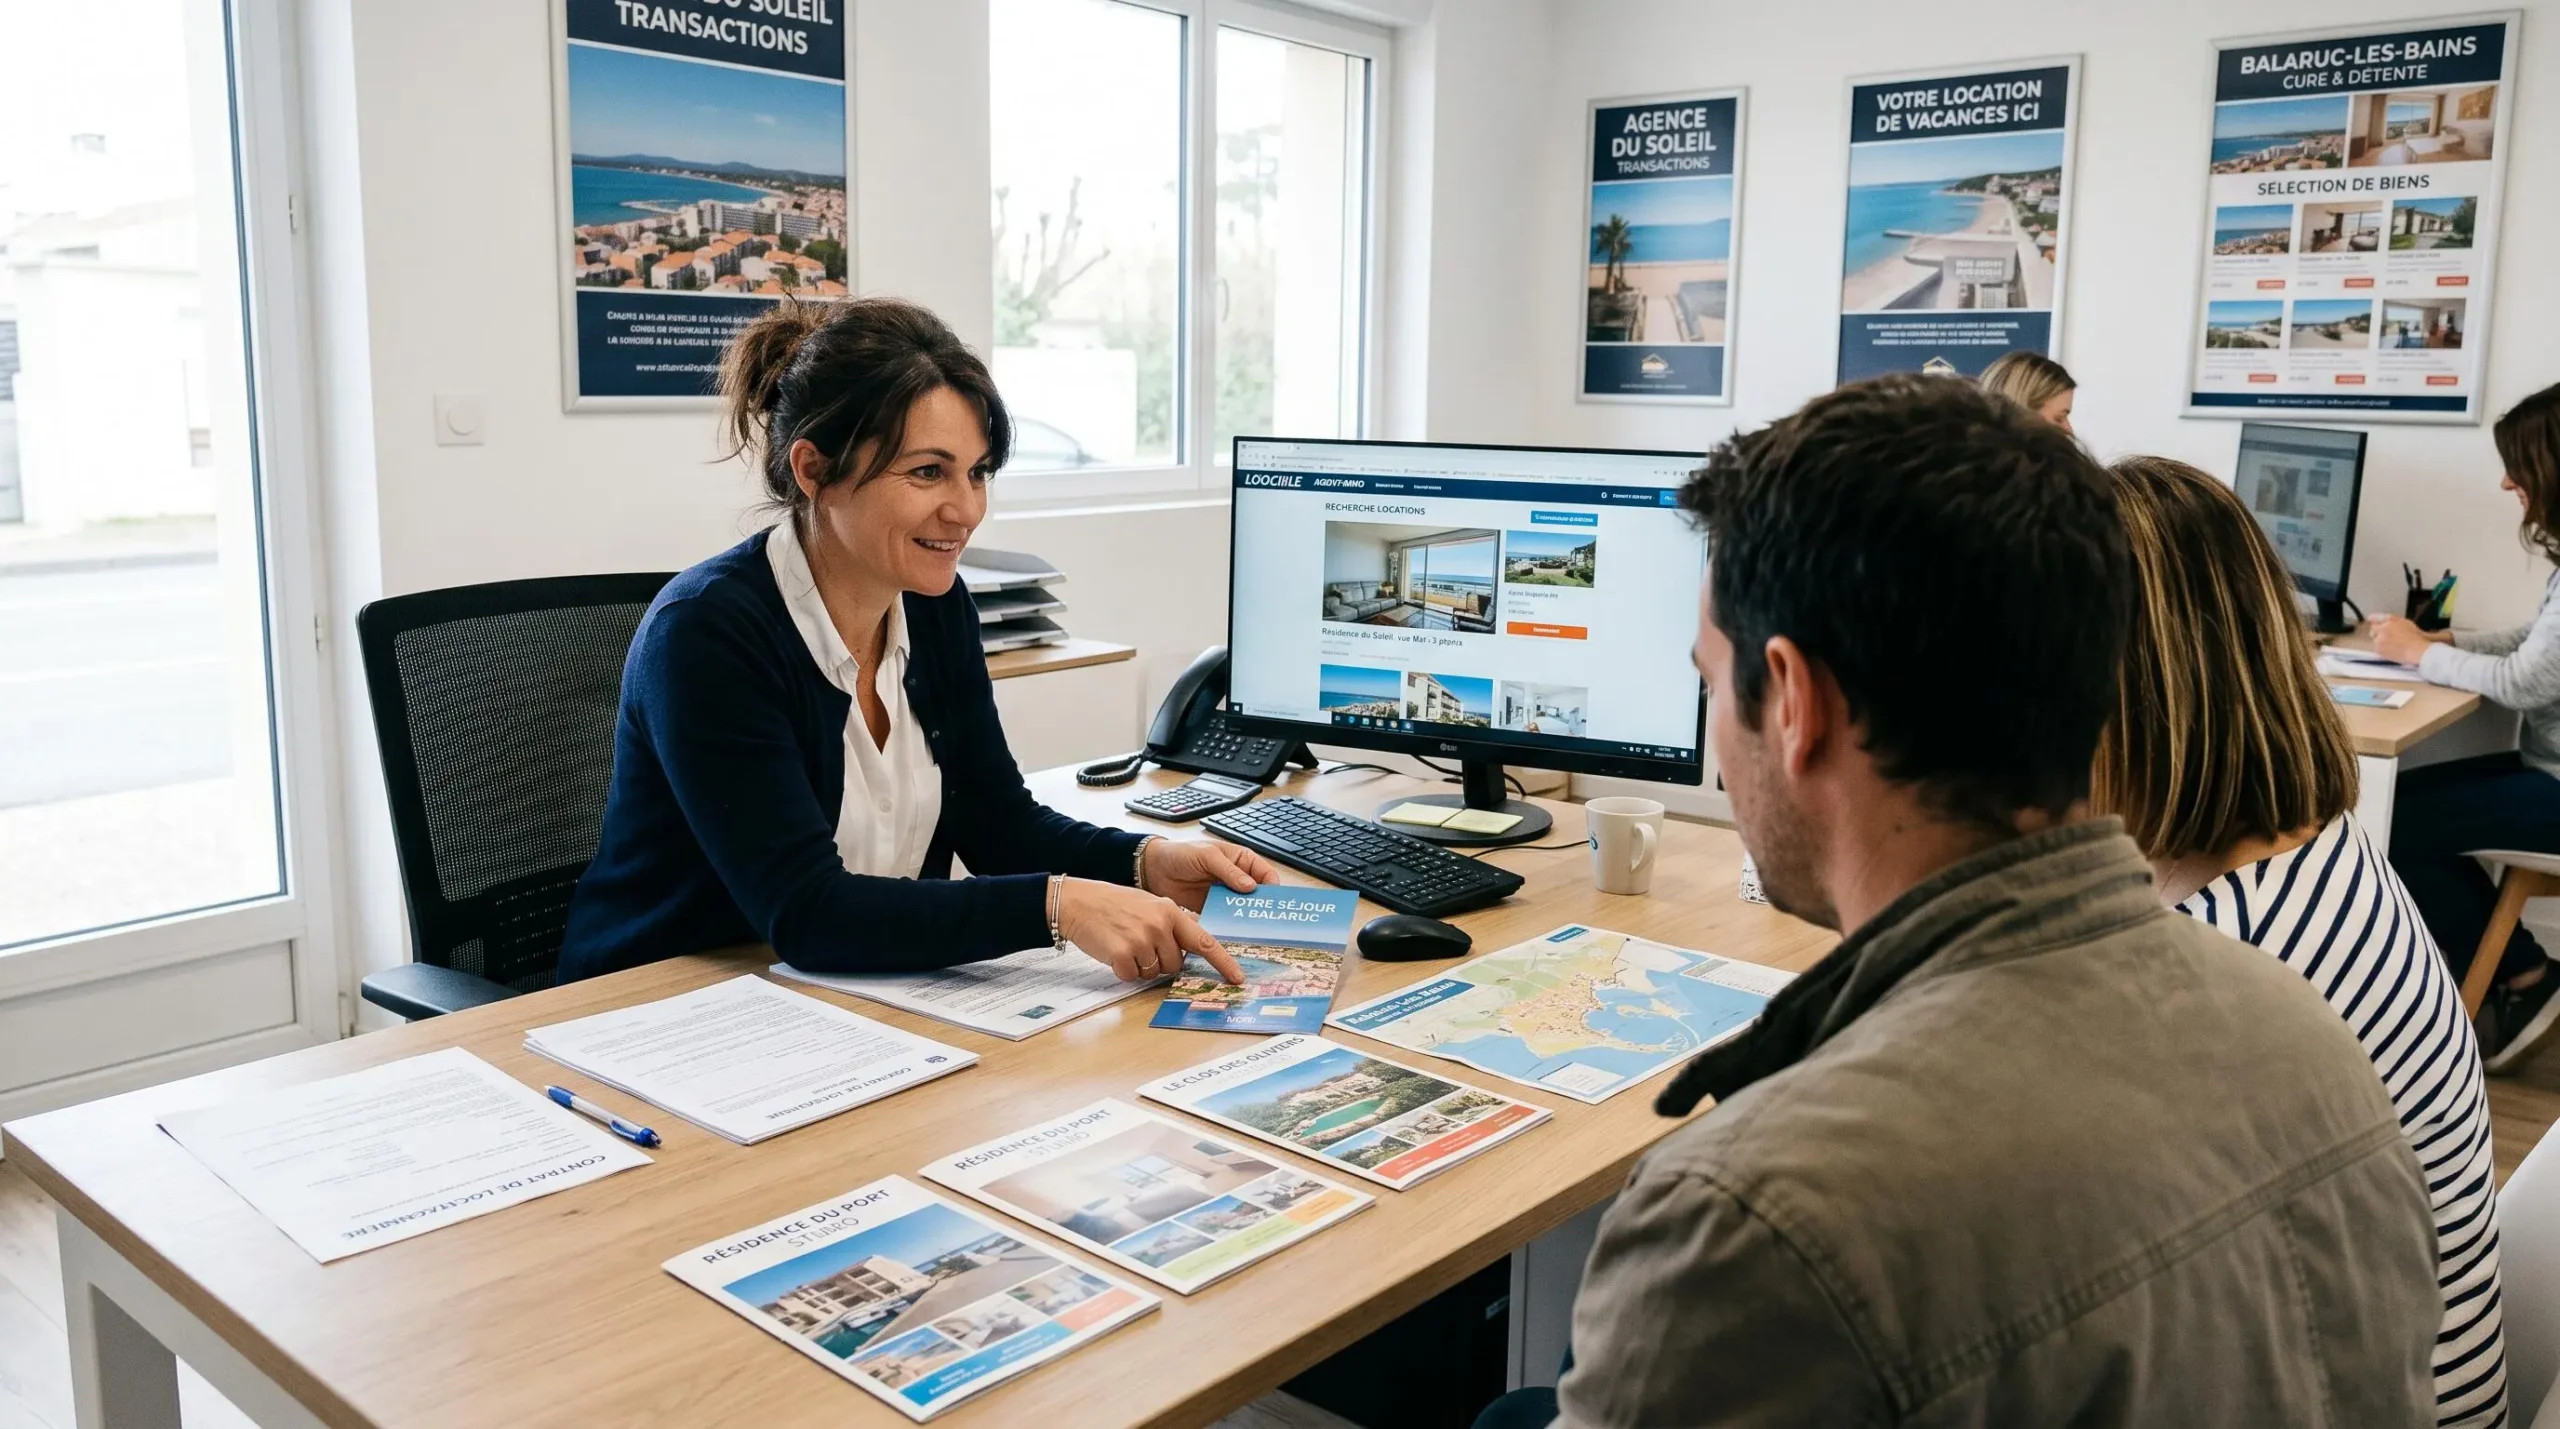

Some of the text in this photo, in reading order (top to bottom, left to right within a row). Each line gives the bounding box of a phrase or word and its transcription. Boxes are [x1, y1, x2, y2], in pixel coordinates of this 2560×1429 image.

[614, 0, 808, 55] TRANSACTIONS
[2240, 36, 2477, 75] BALARUC-LES-BAINS
[2282, 71, 2328, 90] CURE
[2332, 71, 2344, 86] &
[1877, 79, 2042, 111] VOTRE LOCATION
[1623, 107, 1707, 134] AGENCE
[1876, 102, 2039, 133] DE VACANCES ICI
[1611, 130, 1717, 158] DU SOLEIL
[1617, 156, 1710, 174] TRANSACTIONS
[2352, 177, 2374, 191] DE
[2380, 174, 2430, 190] BIENS
[1325, 502, 1426, 515] RECHERCHE LOCATIONS
[1225, 896, 1336, 913] VOTRE SÉJOUR
[1248, 909, 1320, 922] BALARUC
[1162, 1081, 1185, 1092] LE
[1182, 1068, 1221, 1084] CLOS
[1218, 1058, 1248, 1071] DES
[954, 1109, 1112, 1170] RÉSIDENCE DU PORT
[527, 1154, 606, 1184] CONTRAT
[496, 1180, 523, 1193] DE
[702, 1189, 890, 1264] RÉSIDENCE DU PORT
